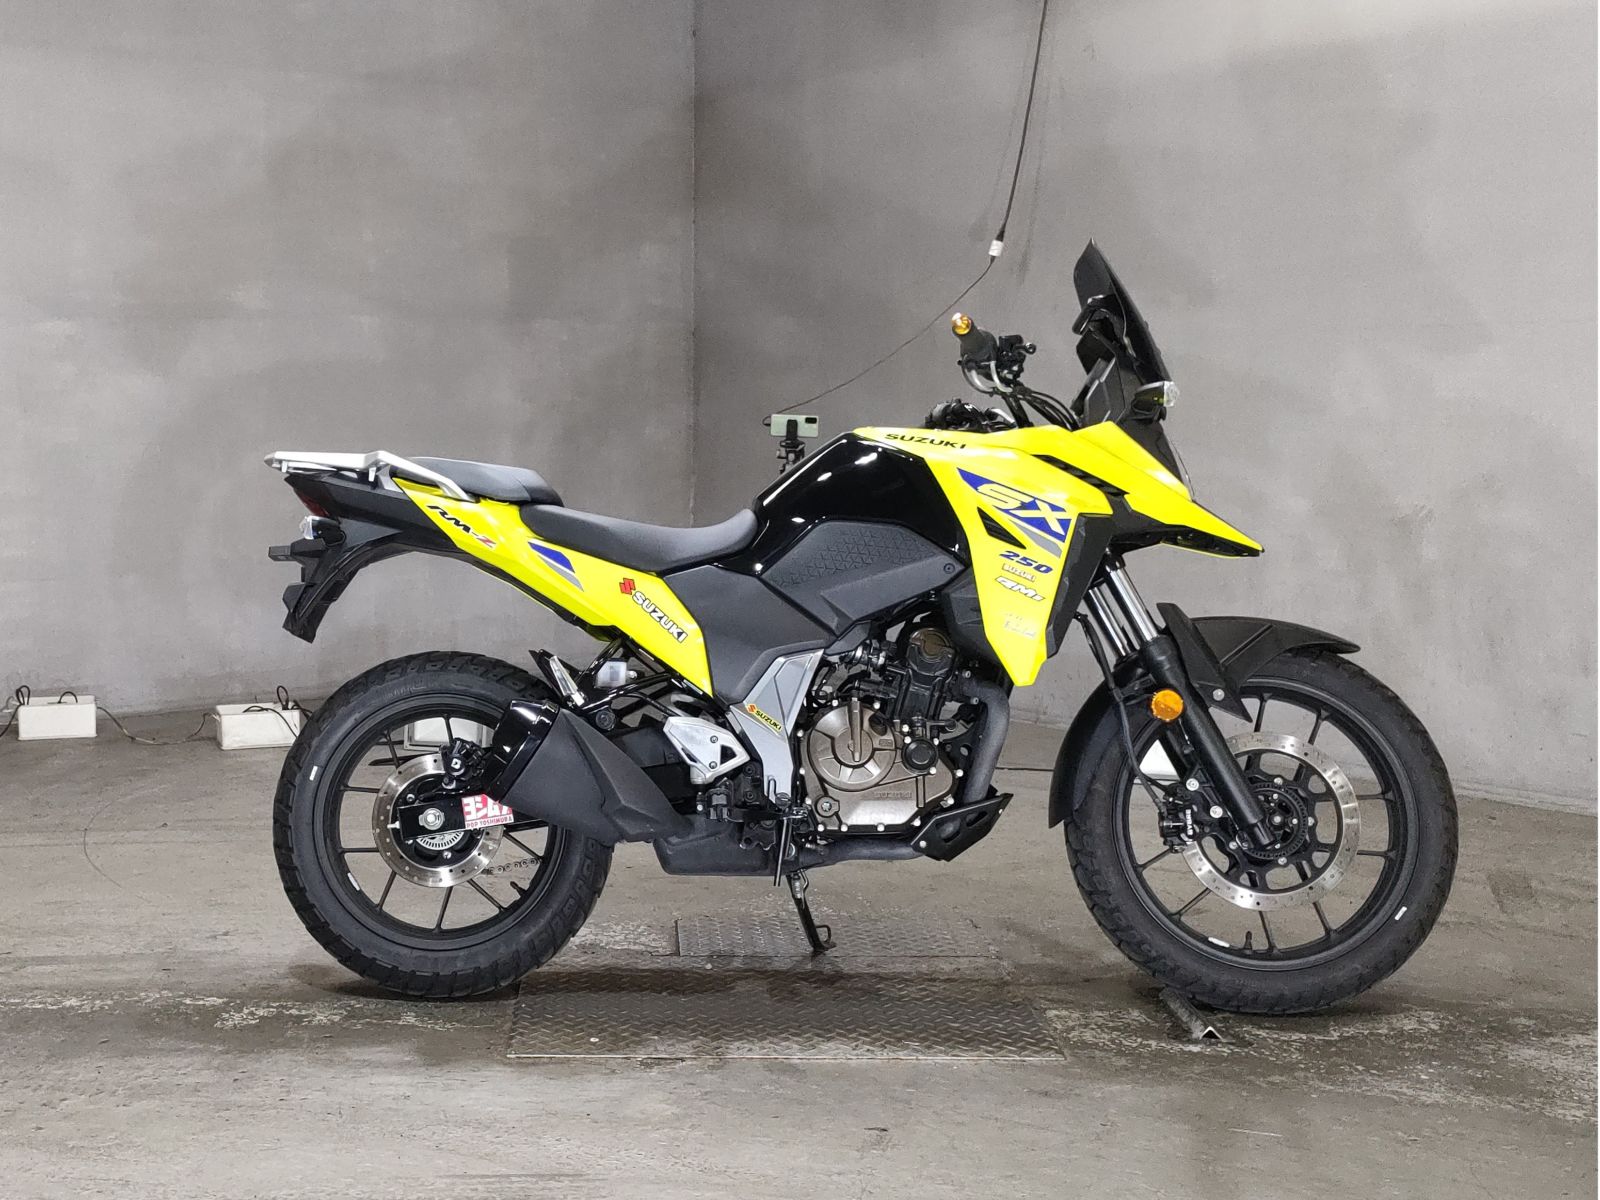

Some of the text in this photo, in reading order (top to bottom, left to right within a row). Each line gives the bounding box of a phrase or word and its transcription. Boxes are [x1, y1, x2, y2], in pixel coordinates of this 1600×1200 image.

[885, 433, 966, 449] SUZUKI
[976, 483, 1068, 537] SX
[999, 550, 1053, 574] 250
[632, 591, 688, 644] SUZUKI
[755, 710, 782, 731] SUZUKI
